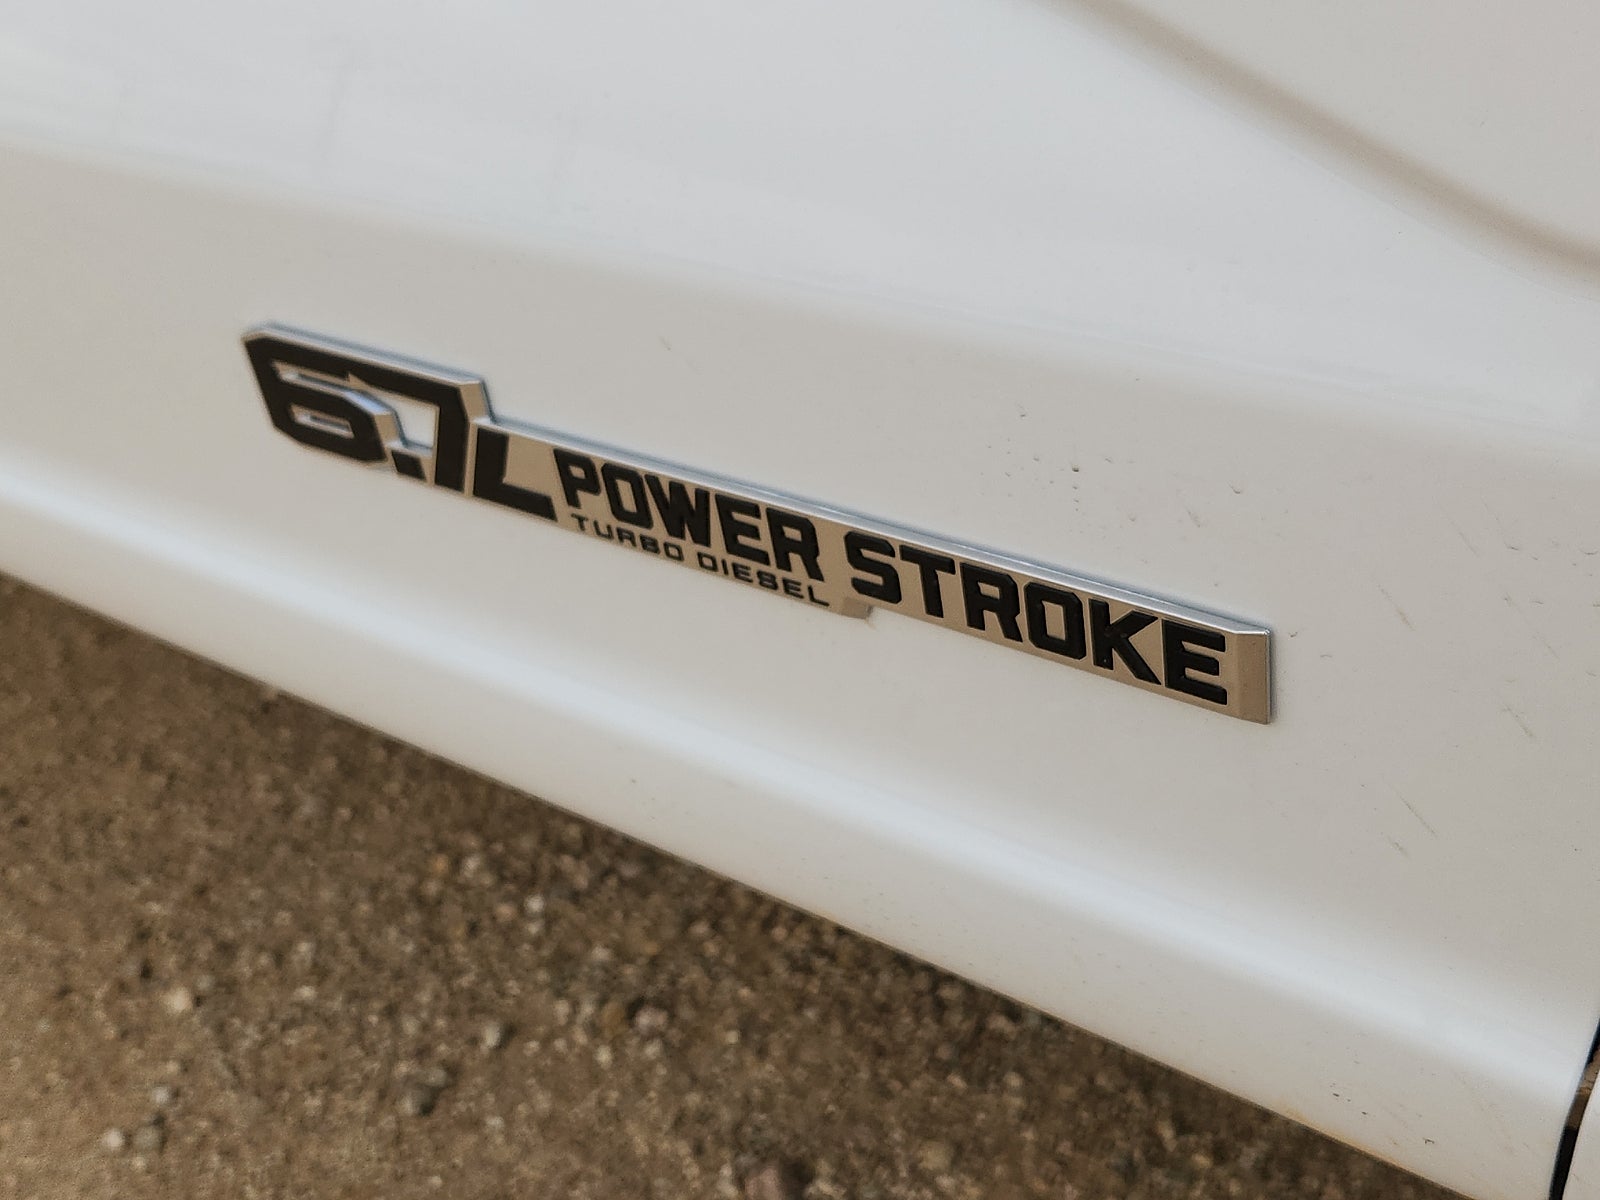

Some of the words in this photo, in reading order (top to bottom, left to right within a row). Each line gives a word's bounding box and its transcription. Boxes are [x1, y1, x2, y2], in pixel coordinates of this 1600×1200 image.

[244, 337, 558, 522] 6.7L
[553, 448, 824, 582] POWER
[843, 531, 1228, 706] STROKE
[570, 512, 684, 562] TURBO
[697, 551, 830, 607] DIESEL
